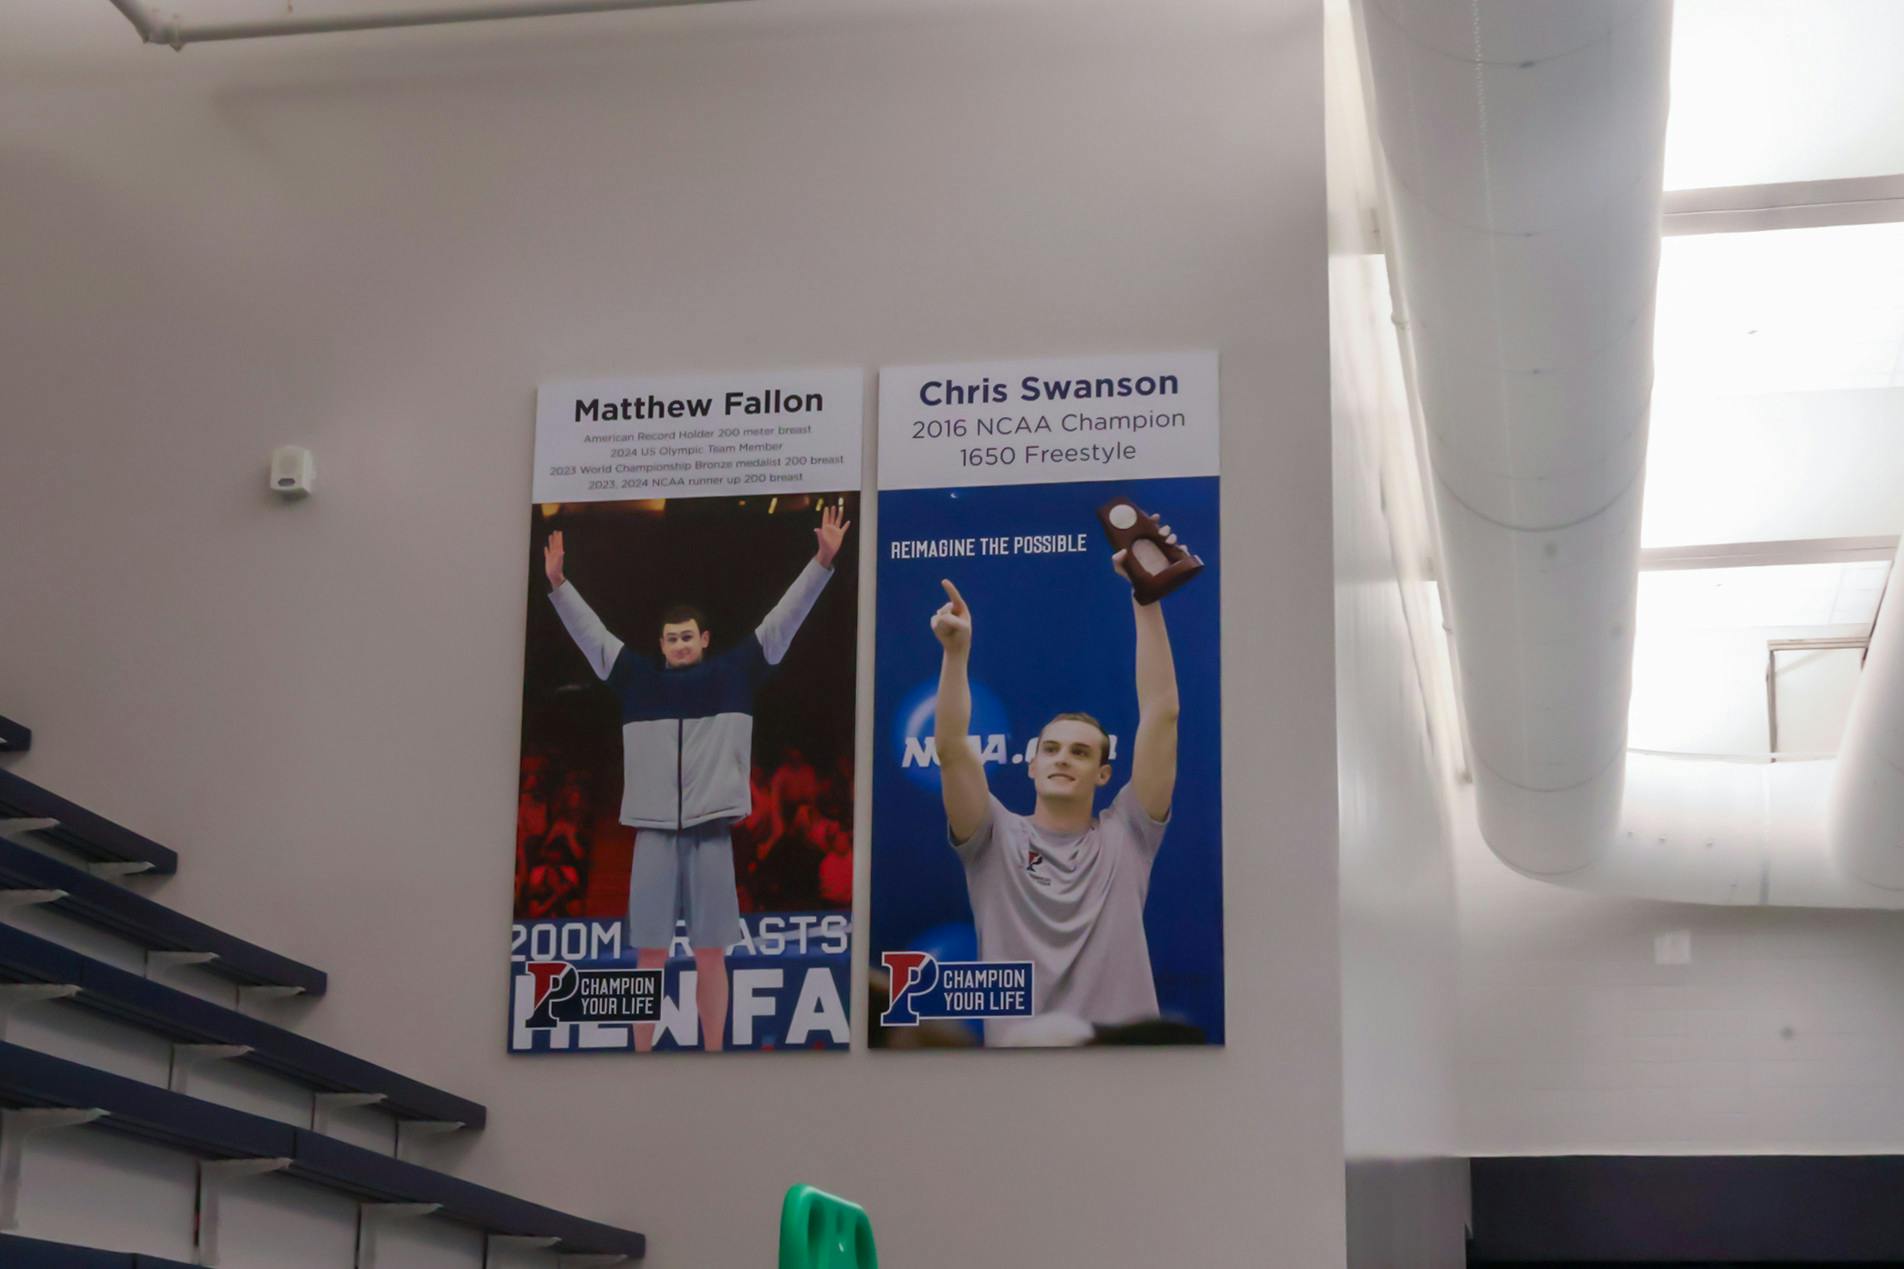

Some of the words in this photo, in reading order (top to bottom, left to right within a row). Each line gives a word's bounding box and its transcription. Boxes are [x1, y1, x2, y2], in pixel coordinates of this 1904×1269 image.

[919, 377, 1008, 407] Chris
[1020, 373, 1179, 401] Swanson
[575, 395, 712, 422] Matthew
[724, 389, 823, 416] Fallon
[583, 433, 635, 444] American
[637, 430, 676, 441] Record
[678, 428, 715, 440] Holder
[718, 427, 741, 438] 200
[743, 427, 775, 436] meter
[777, 424, 812, 436] breast
[911, 419, 968, 440] 2016
[977, 415, 1052, 437] NCAA
[1061, 409, 1186, 433] Champion
[610, 447, 638, 458] 2024
[641, 446, 656, 456] US
[659, 444, 704, 457] Olympic
[707, 444, 736, 454] Team
[739, 442, 784, 452] Member
[960, 446, 1016, 467] 1650
[1025, 441, 1137, 465] Freestyle
[549, 465, 577, 476] 2023
[580, 462, 613, 475] World
[614, 461, 693, 474] Championship
[694, 458, 734, 470] Bronze
[735, 457, 781, 469] medalist
[784, 455, 808, 467] 200
[810, 455, 844, 465] breast
[620, 477, 649, 489] 2024
[651, 477, 686, 488] NCAA
[688, 475, 724, 486] runner
[726, 475, 742, 485] up
[743, 473, 767, 484] 200
[769, 472, 803, 482] breast
[890, 537, 976, 560] REIMAGINE
[980, 536, 1009, 556] THE
[1013, 533, 1088, 555] POSSIBLE
[580, 977, 655, 997] CHAMPION
[943, 968, 1026, 989] CHAMPION
[580, 998, 618, 1016] YOUR
[621, 997, 655, 1015] LIFE
[943, 991, 985, 1012] YOUR
[989, 990, 1026, 1010] LIFE
